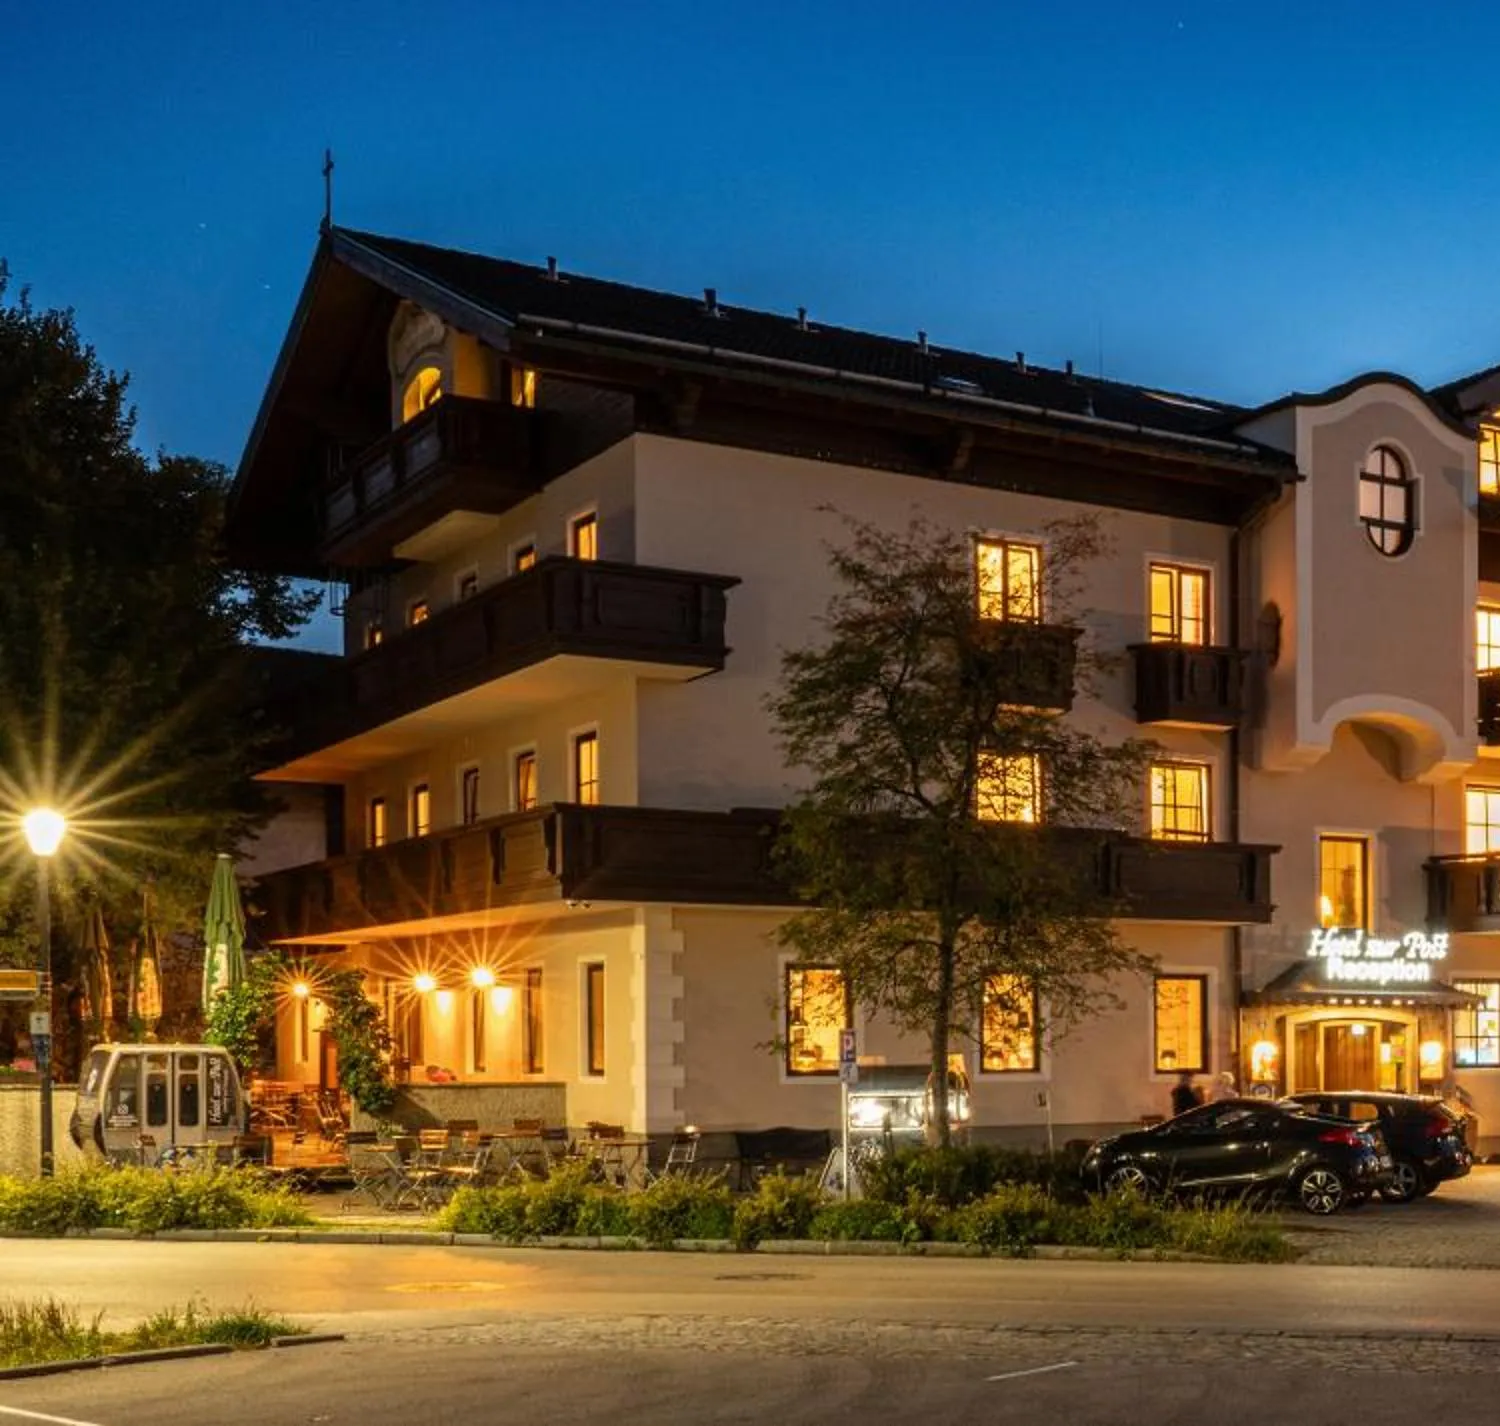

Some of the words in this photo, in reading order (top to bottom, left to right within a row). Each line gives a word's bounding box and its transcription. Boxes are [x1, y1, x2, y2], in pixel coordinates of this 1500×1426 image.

[1307, 927, 1363, 957] Hotel
[1364, 938, 1400, 958] zur
[1404, 931, 1449, 960] Post
[1327, 958, 1431, 986] Reception
